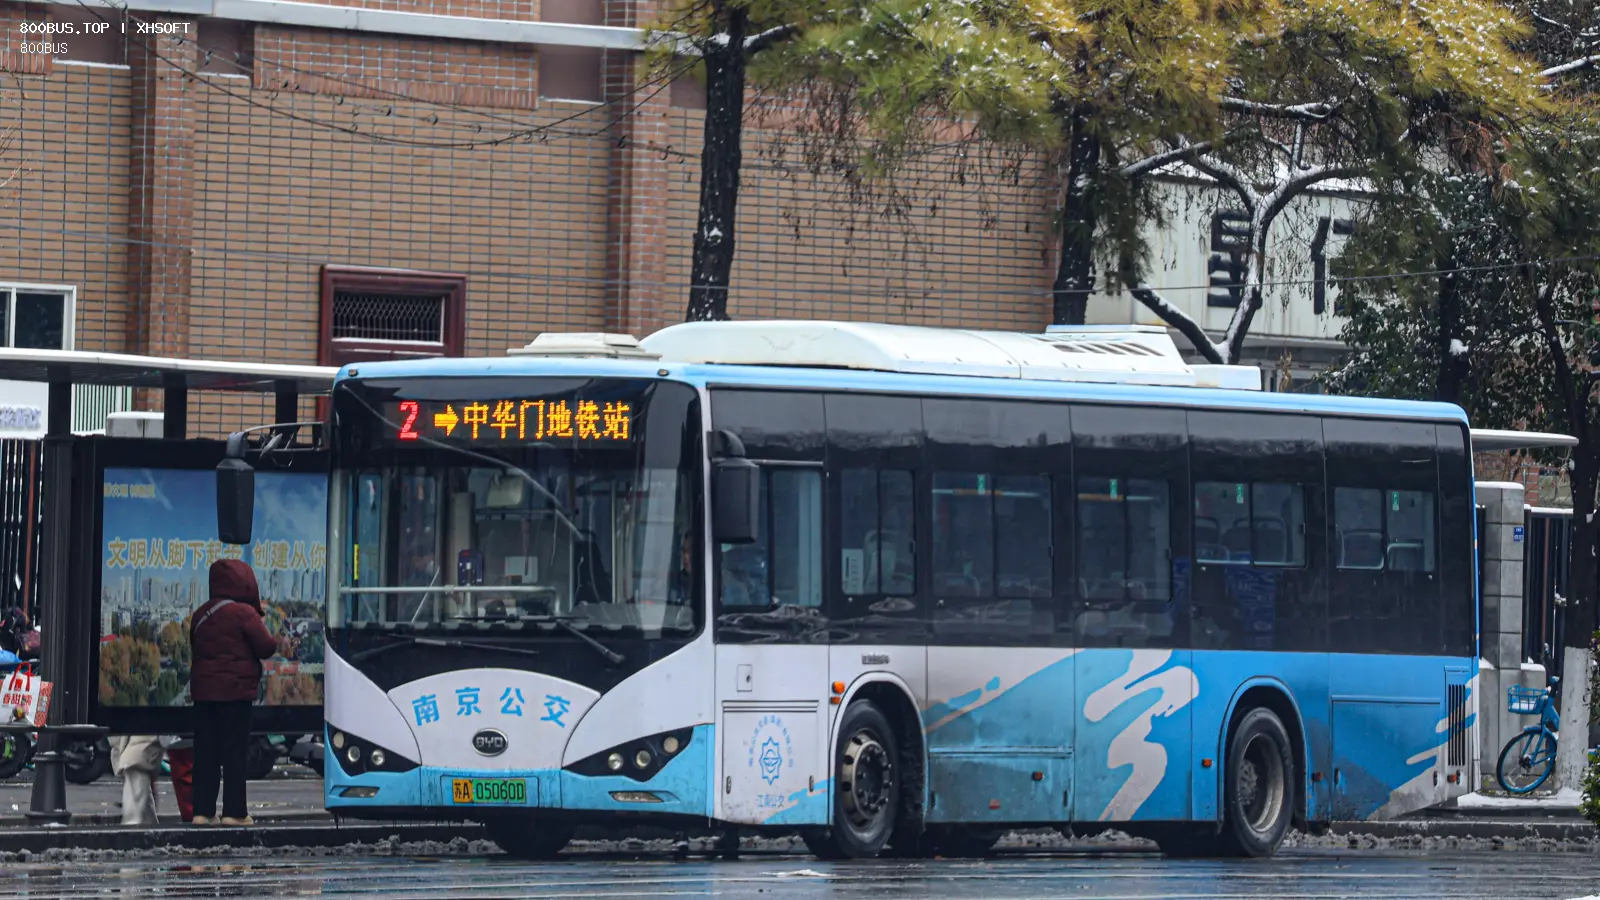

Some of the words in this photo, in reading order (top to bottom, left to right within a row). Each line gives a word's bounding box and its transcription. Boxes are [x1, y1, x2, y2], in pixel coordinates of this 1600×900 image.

[400, 401, 419, 439] 2
[463, 400, 630, 439] 中华门地铁站
[412, 686, 571, 729] 南京公交
[475, 736, 503, 749] BYD
